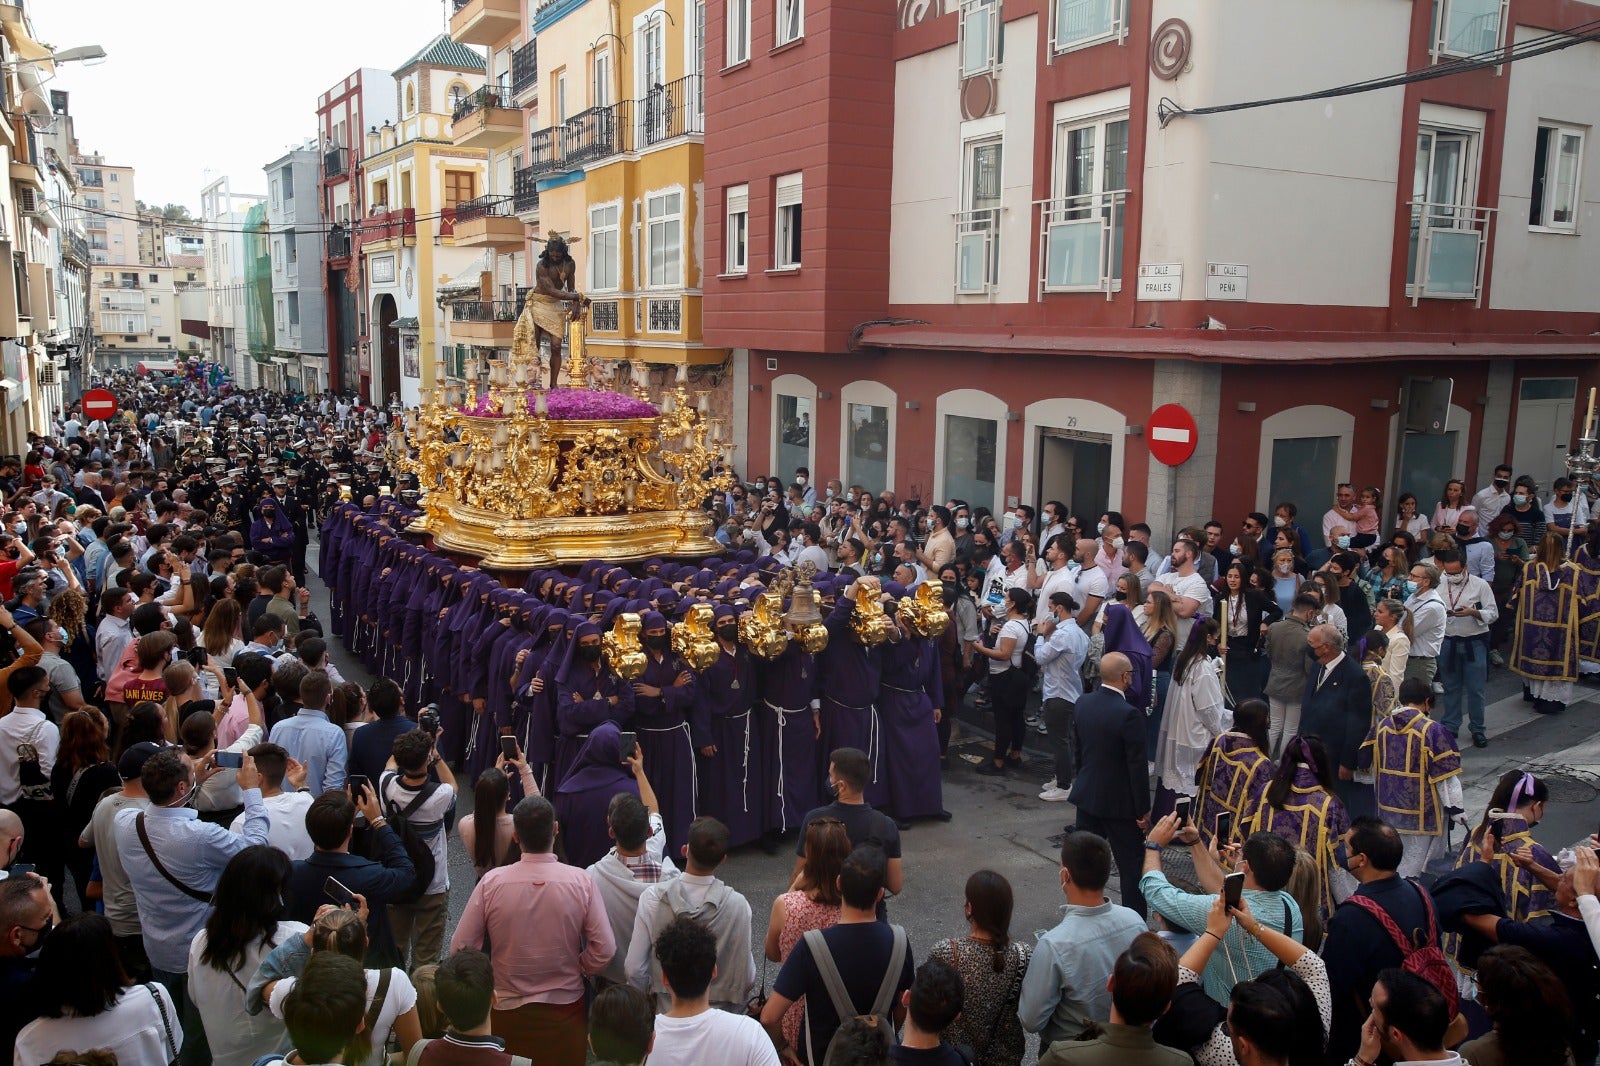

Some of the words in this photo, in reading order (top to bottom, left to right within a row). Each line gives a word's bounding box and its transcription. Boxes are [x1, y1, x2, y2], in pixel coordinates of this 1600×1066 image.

[1154, 266, 1168, 275] CALLE
[1223, 266, 1237, 274] CALLE
[1145, 283, 1172, 292] FRAILES
[1219, 281, 1236, 292] PEÑA
[1067, 416, 1077, 427] 29
[141, 690, 163, 701] ALVES
